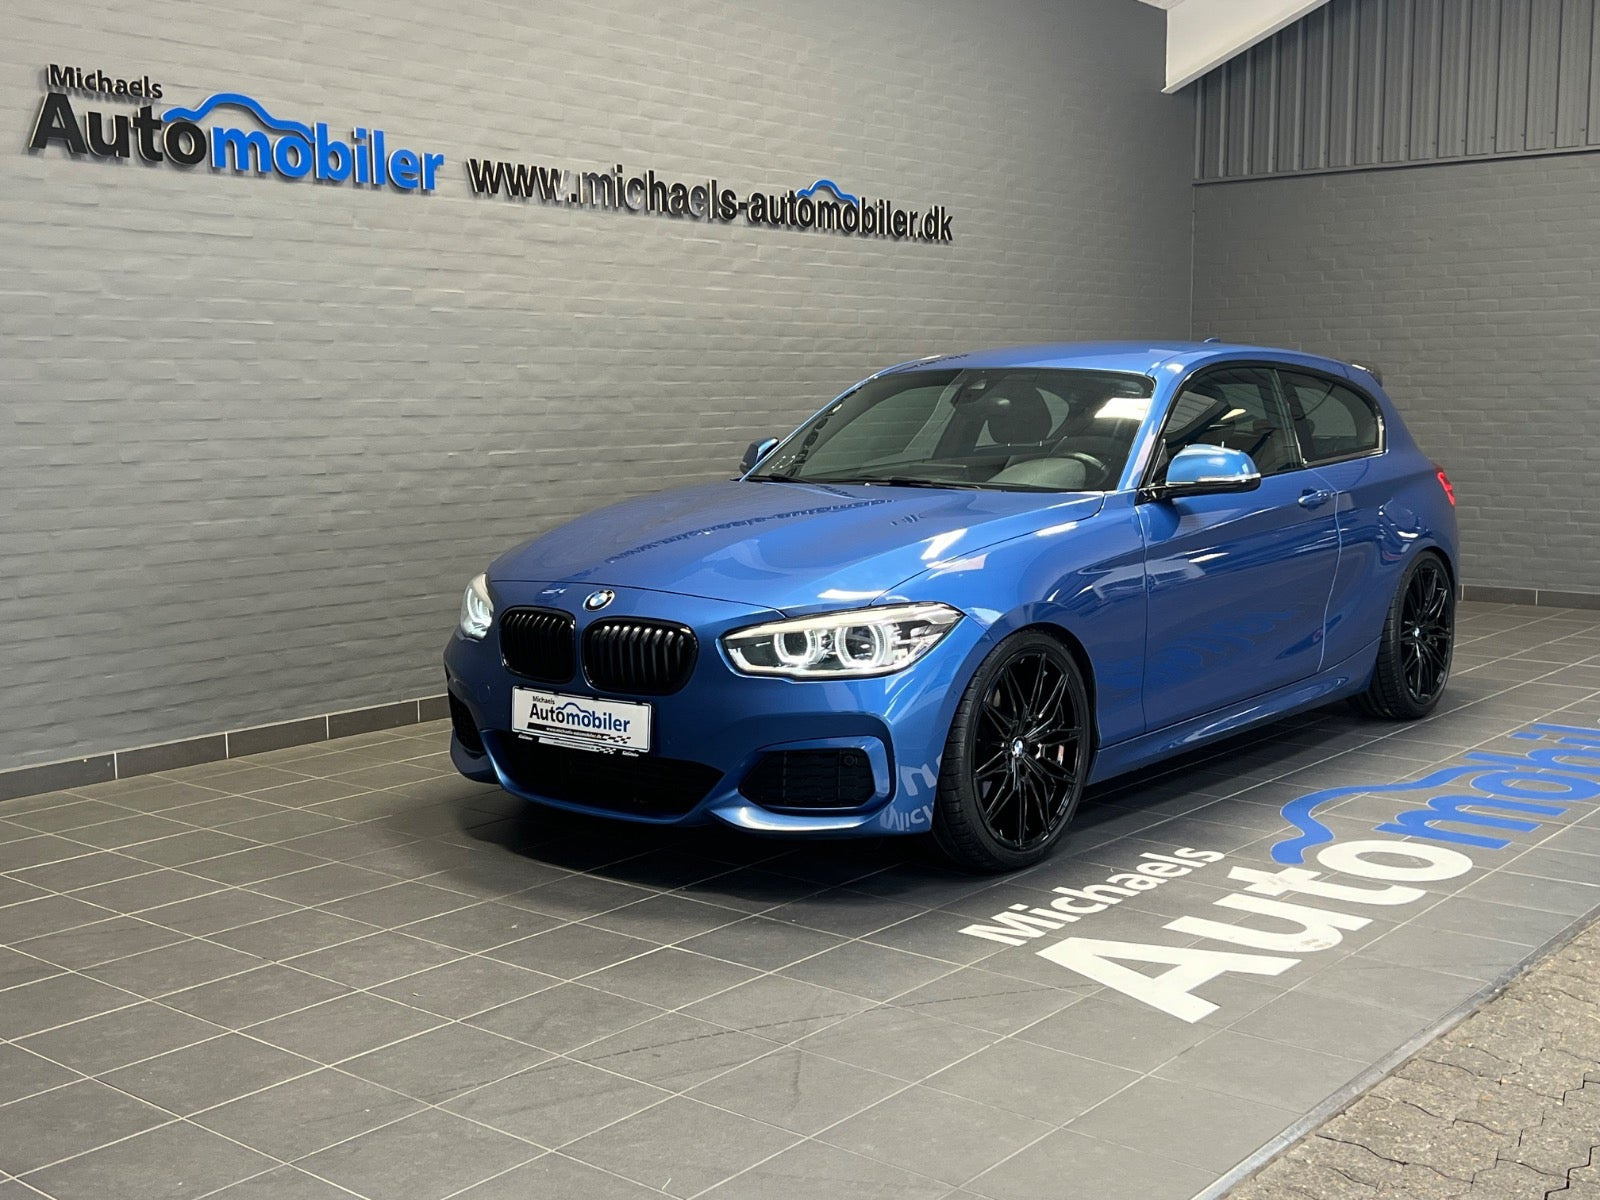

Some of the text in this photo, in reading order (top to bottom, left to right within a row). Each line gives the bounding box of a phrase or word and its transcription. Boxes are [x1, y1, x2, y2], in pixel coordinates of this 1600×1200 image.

[47, 64, 163, 99] Michaels
[29, 92, 444, 190] Automobiler
[466, 157, 954, 241] www.michaels-automobiler.dk
[529, 703, 630, 733] Automobiler
[532, 695, 556, 705] Michaels
[958, 846, 1225, 946] Michaels
